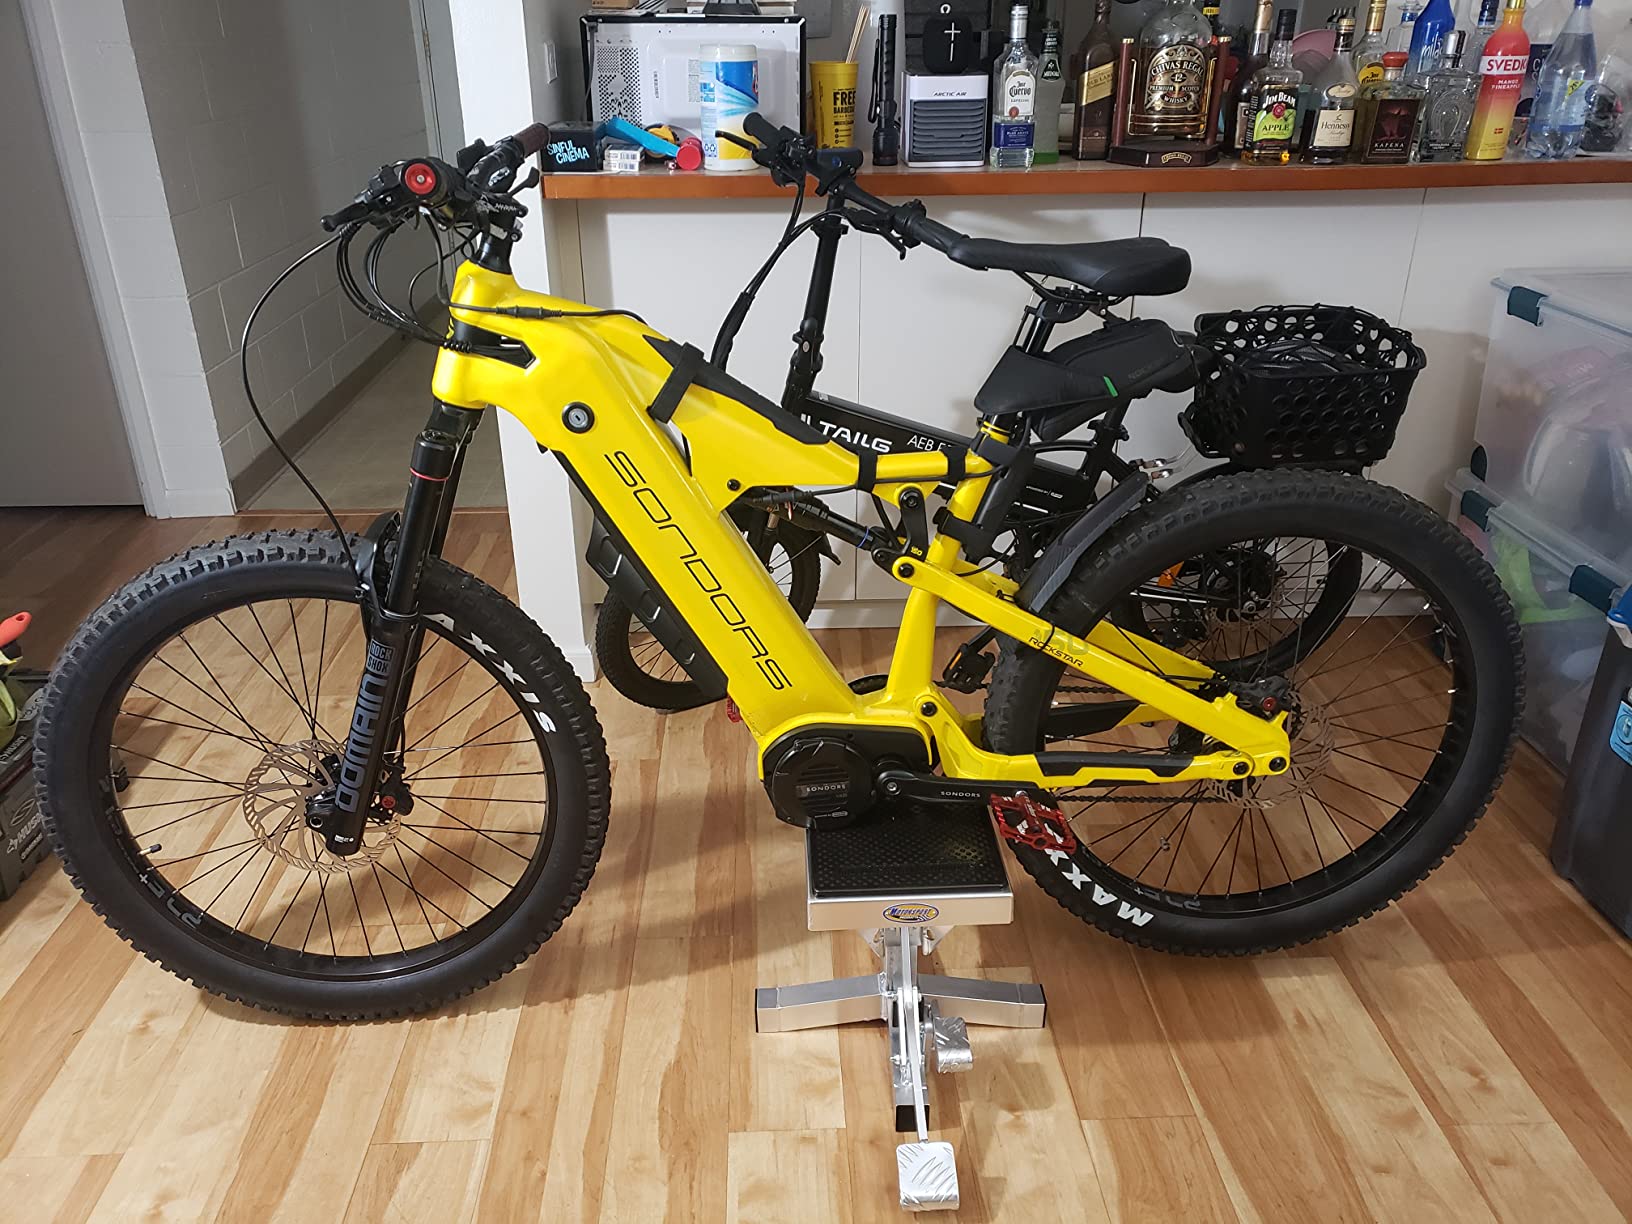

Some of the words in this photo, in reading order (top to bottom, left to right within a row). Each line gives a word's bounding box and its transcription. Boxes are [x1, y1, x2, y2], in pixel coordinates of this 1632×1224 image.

[1151, 60, 1181, 77] CHIVAS
[1182, 60, 1205, 77] REGAL
[1486, 58, 1527, 72] SVEDK
[1174, 73, 1183, 82] 12
[833, 90, 857, 106] FREE
[1008, 87, 1031, 98] Cuervo
[1164, 94, 1189, 104] WHISKY
[1262, 94, 1278, 109] JIM
[1279, 91, 1296, 108] BEAM
[1262, 123, 1290, 132] APPLE
[546, 140, 577, 156] SINFUL
[555, 147, 590, 164] CINEMA
[818, 420, 893, 453] TAILG
[907, 434, 935, 451] AEB
[603, 450, 793, 691] SONDORS
[370, 641, 392, 661] ROCK
[1028, 636, 1085, 667] ROCKSTAR
[367, 655, 389, 673] SHOX
[422, 612, 557, 733] AXXIS
[334, 672, 389, 813] DOMAIN
[806, 784, 846, 792] SONDORS
[940, 790, 981, 798] SONDORS
[1043, 848, 1155, 927] MAXX
